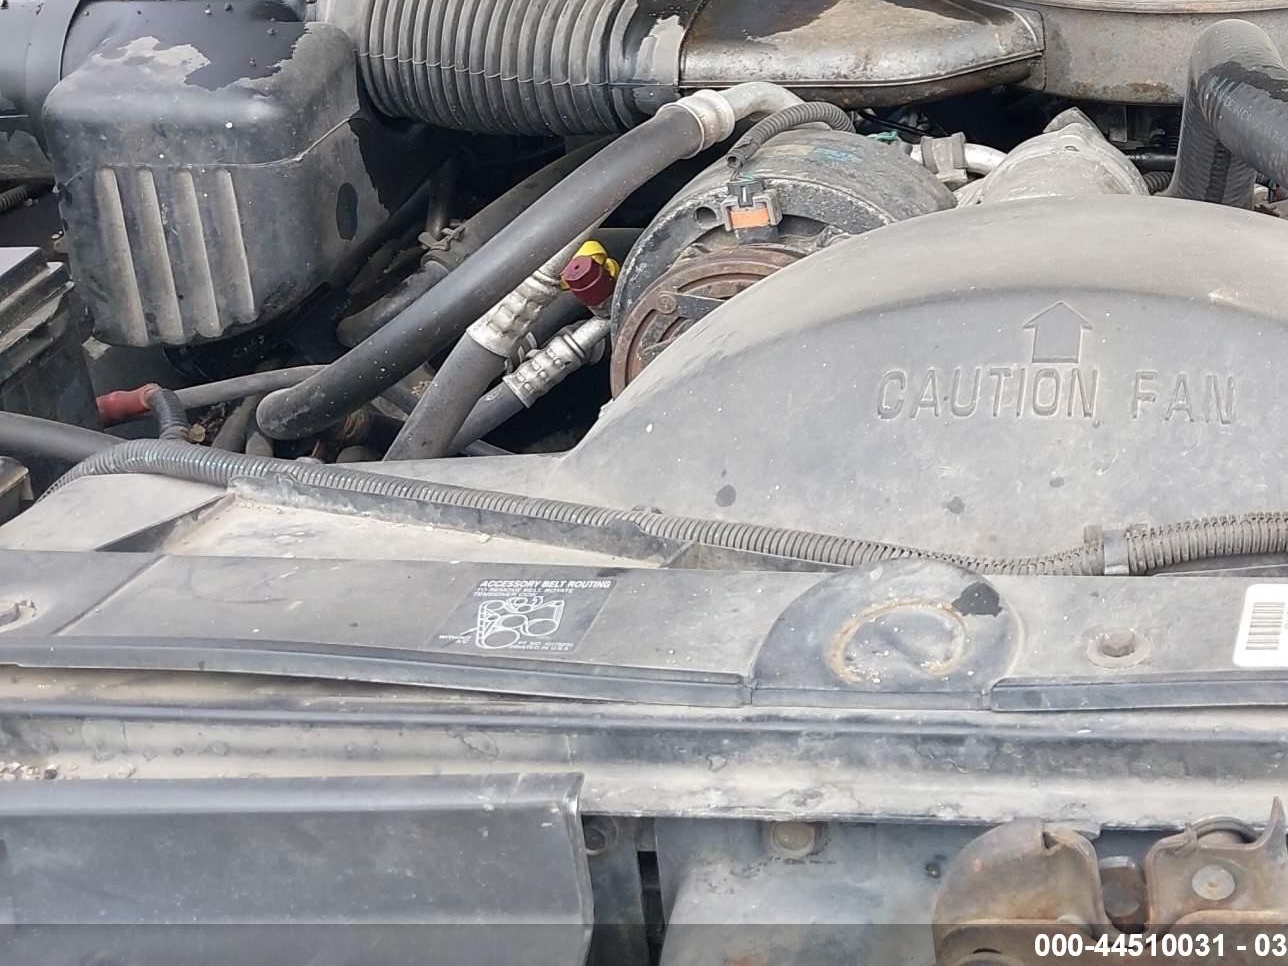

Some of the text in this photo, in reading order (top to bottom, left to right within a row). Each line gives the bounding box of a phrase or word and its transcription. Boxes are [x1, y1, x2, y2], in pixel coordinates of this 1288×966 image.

[877, 366, 1236, 425] CAUTION FAN
[480, 580, 612, 589] ACCESSORY BELT ROUTING
